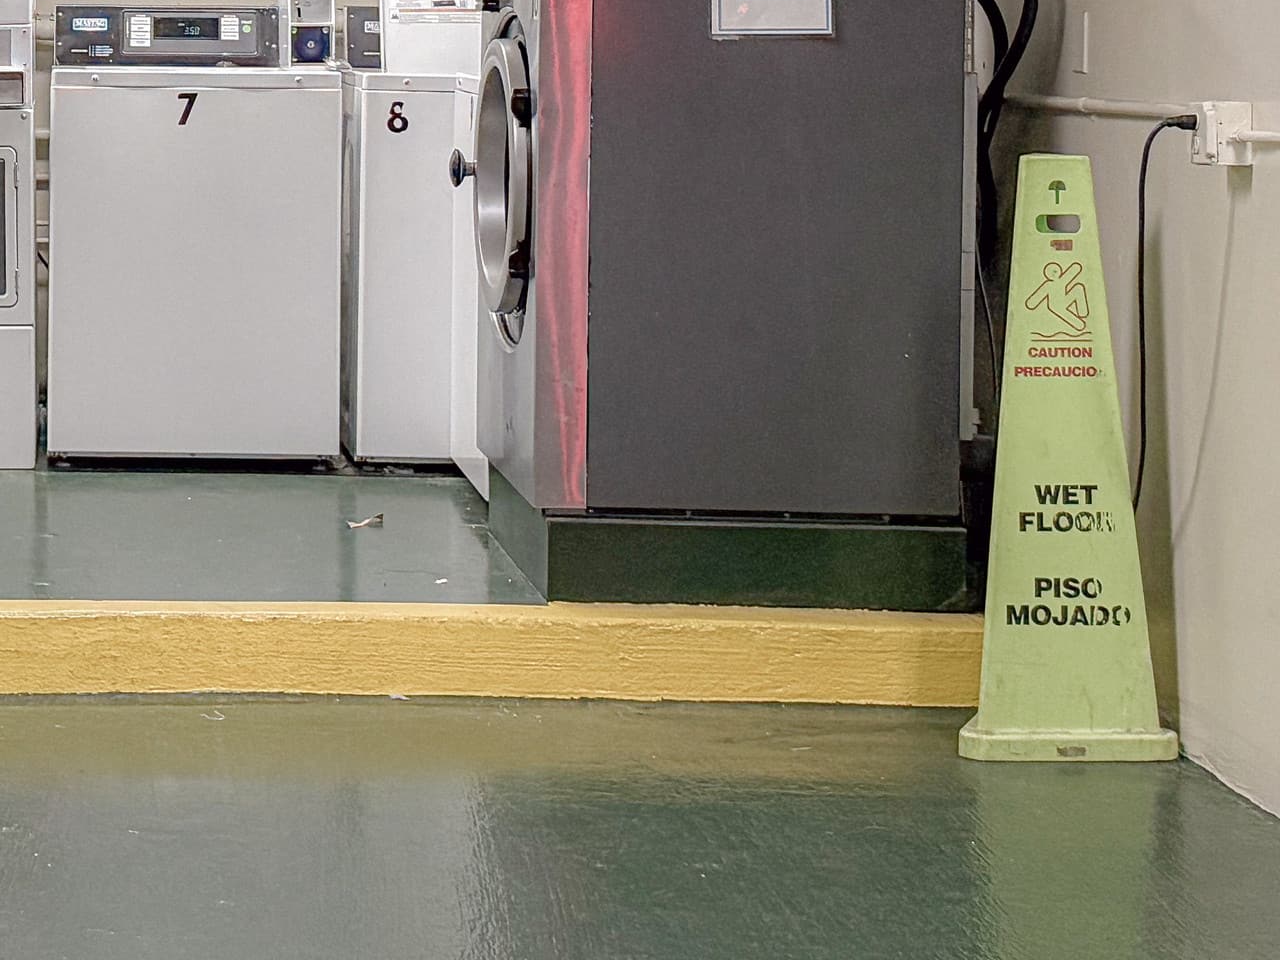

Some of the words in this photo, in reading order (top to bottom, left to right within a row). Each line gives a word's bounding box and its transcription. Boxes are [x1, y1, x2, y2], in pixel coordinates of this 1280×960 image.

[177, 93, 198, 125] 7
[387, 101, 409, 133] 8
[1028, 347, 1093, 358] CAUTION
[1014, 366, 1106, 377] PRECAUCIO
[1034, 485, 1098, 505] WET
[1035, 577, 1102, 599] PISO
[1006, 604, 1131, 626] MOJADO
